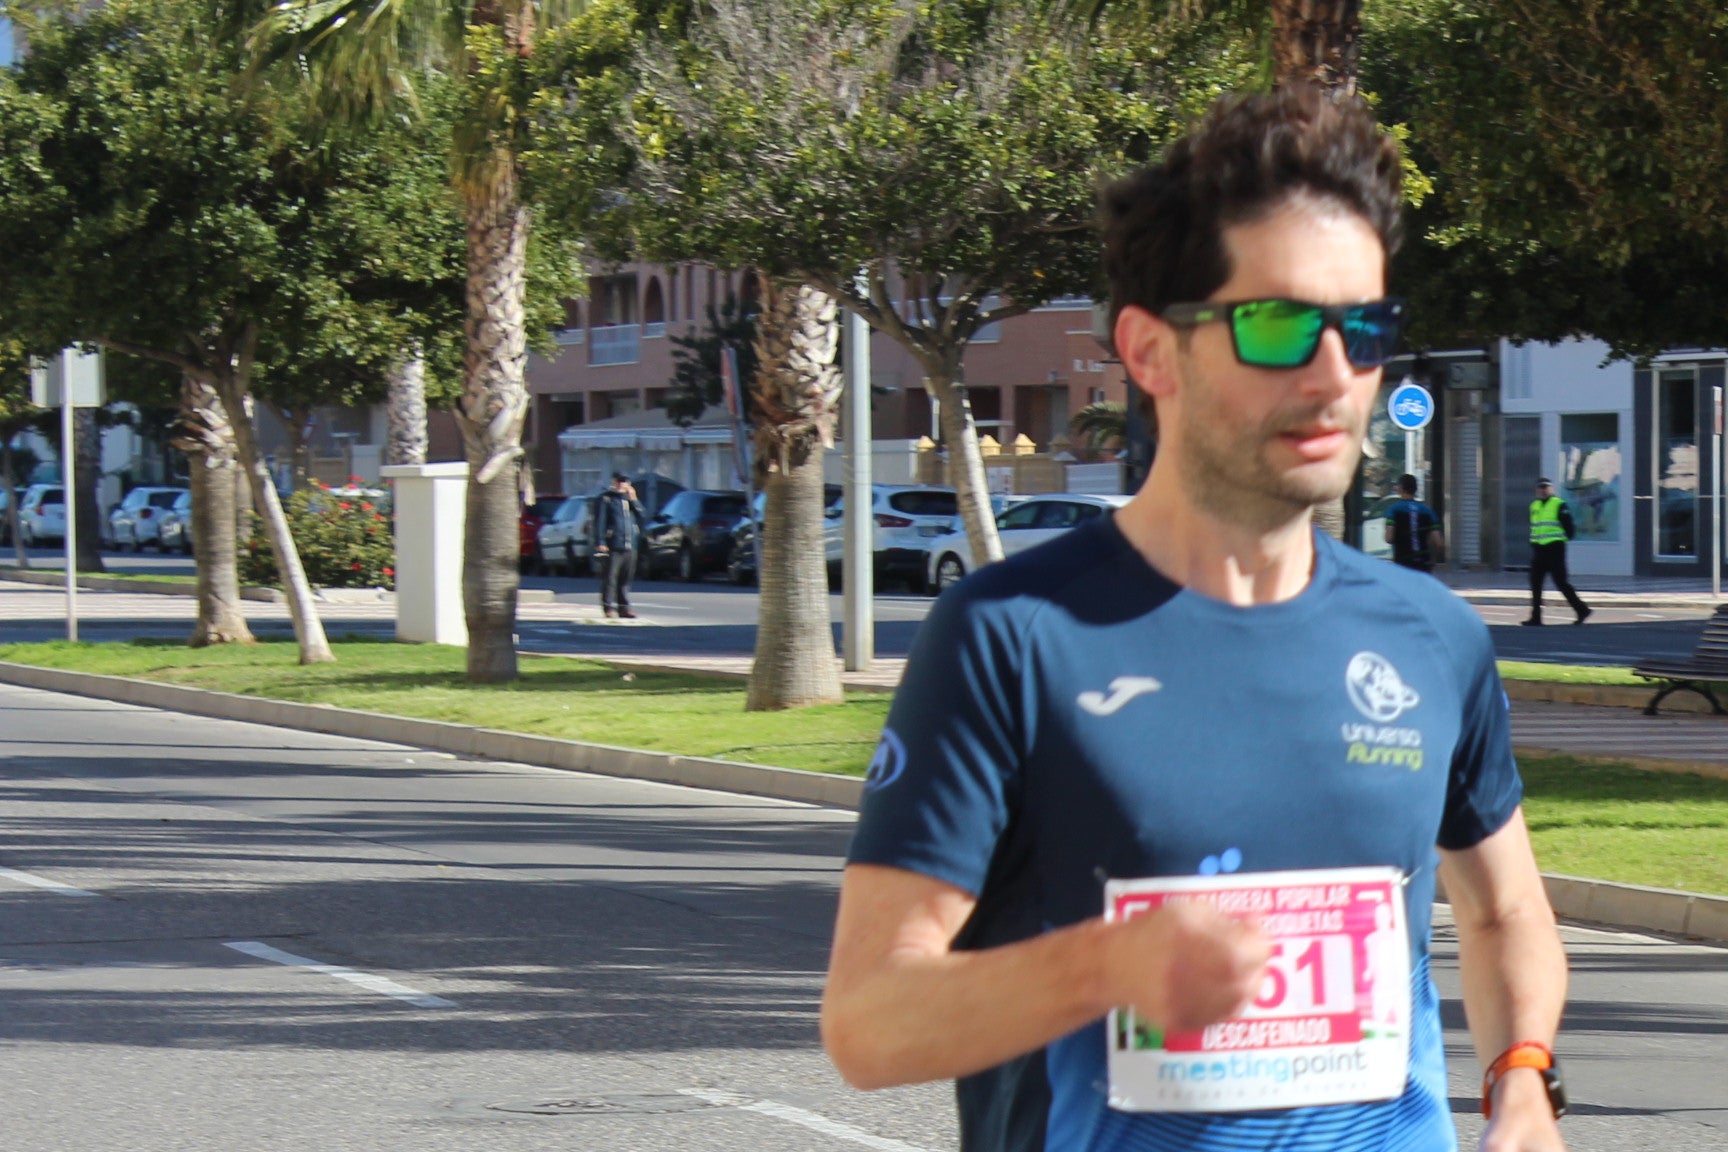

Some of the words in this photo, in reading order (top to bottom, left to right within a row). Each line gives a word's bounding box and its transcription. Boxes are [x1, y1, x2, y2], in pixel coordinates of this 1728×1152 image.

[1276, 884, 1350, 910] POPULAR
[1253, 940, 1327, 1010] 51
[1202, 1017, 1331, 1050] DESCAFEINADO
